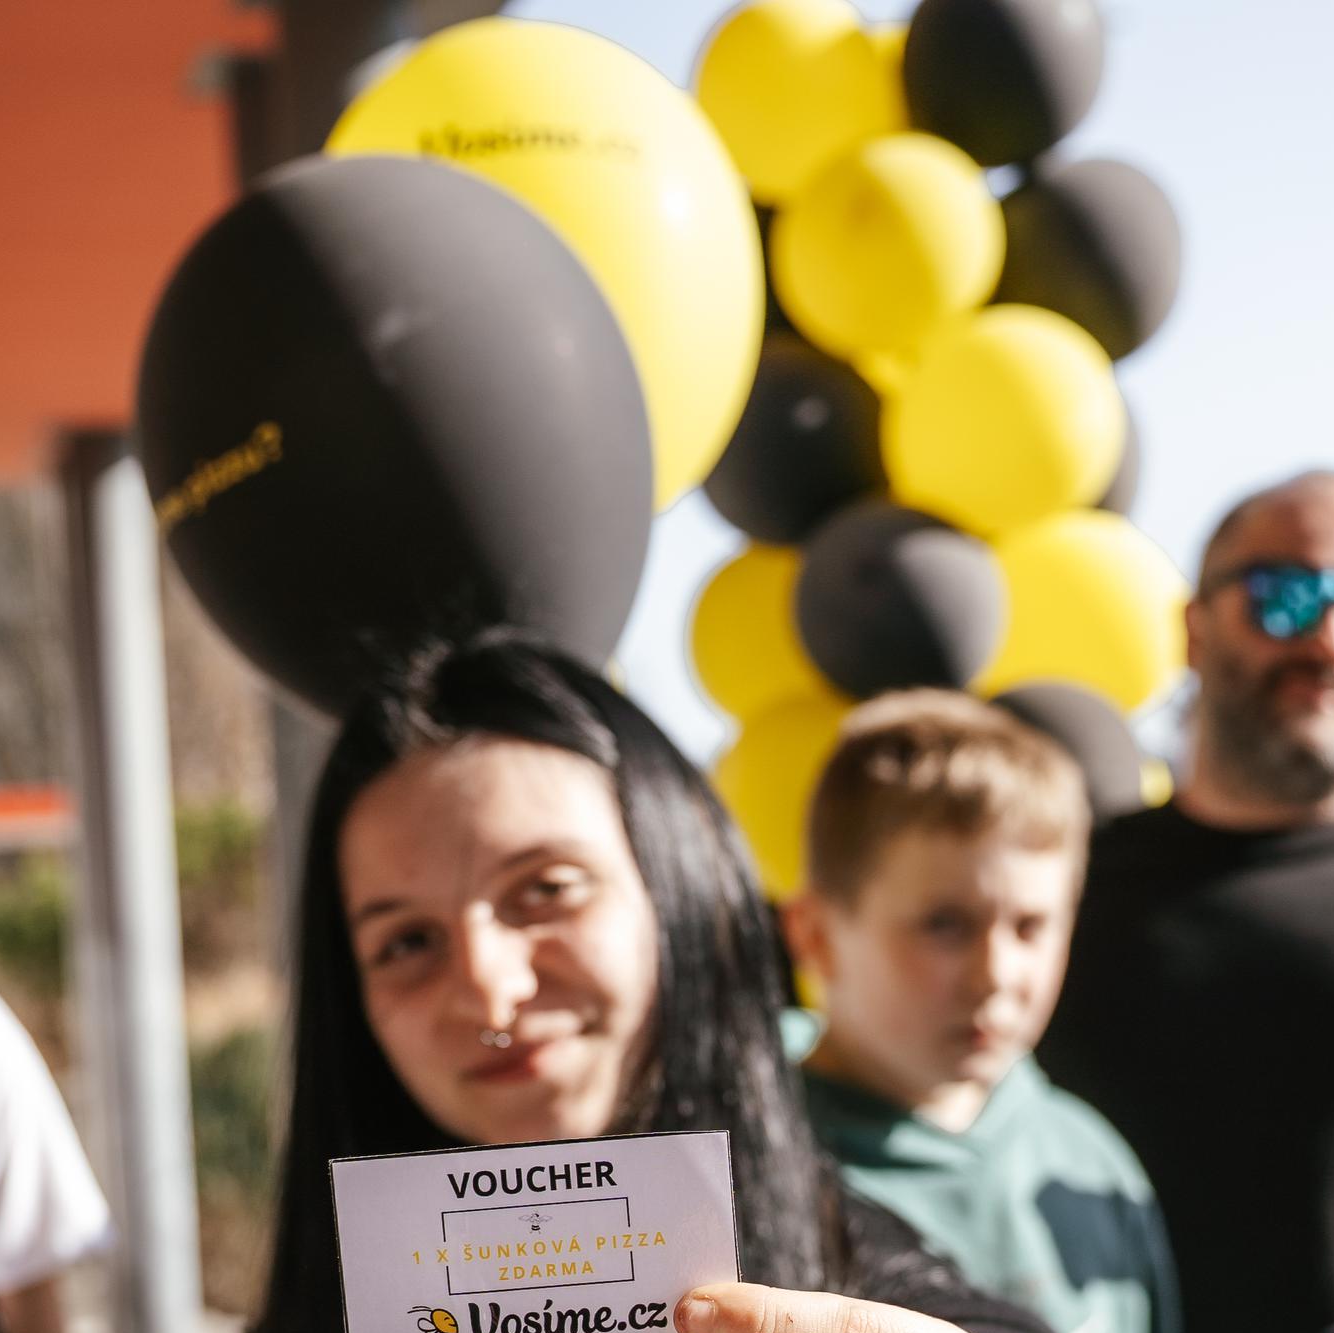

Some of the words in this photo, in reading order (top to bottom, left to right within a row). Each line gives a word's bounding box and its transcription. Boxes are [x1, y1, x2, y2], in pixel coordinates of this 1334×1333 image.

[447, 1160, 617, 1199] VOUCHER
[412, 1251, 421, 1265] 1
[436, 1249, 450, 1264] X
[463, 1234, 582, 1262] ŠUNKOVÁ
[596, 1231, 667, 1251] PIZZA
[498, 1260, 596, 1282] ZDARMA
